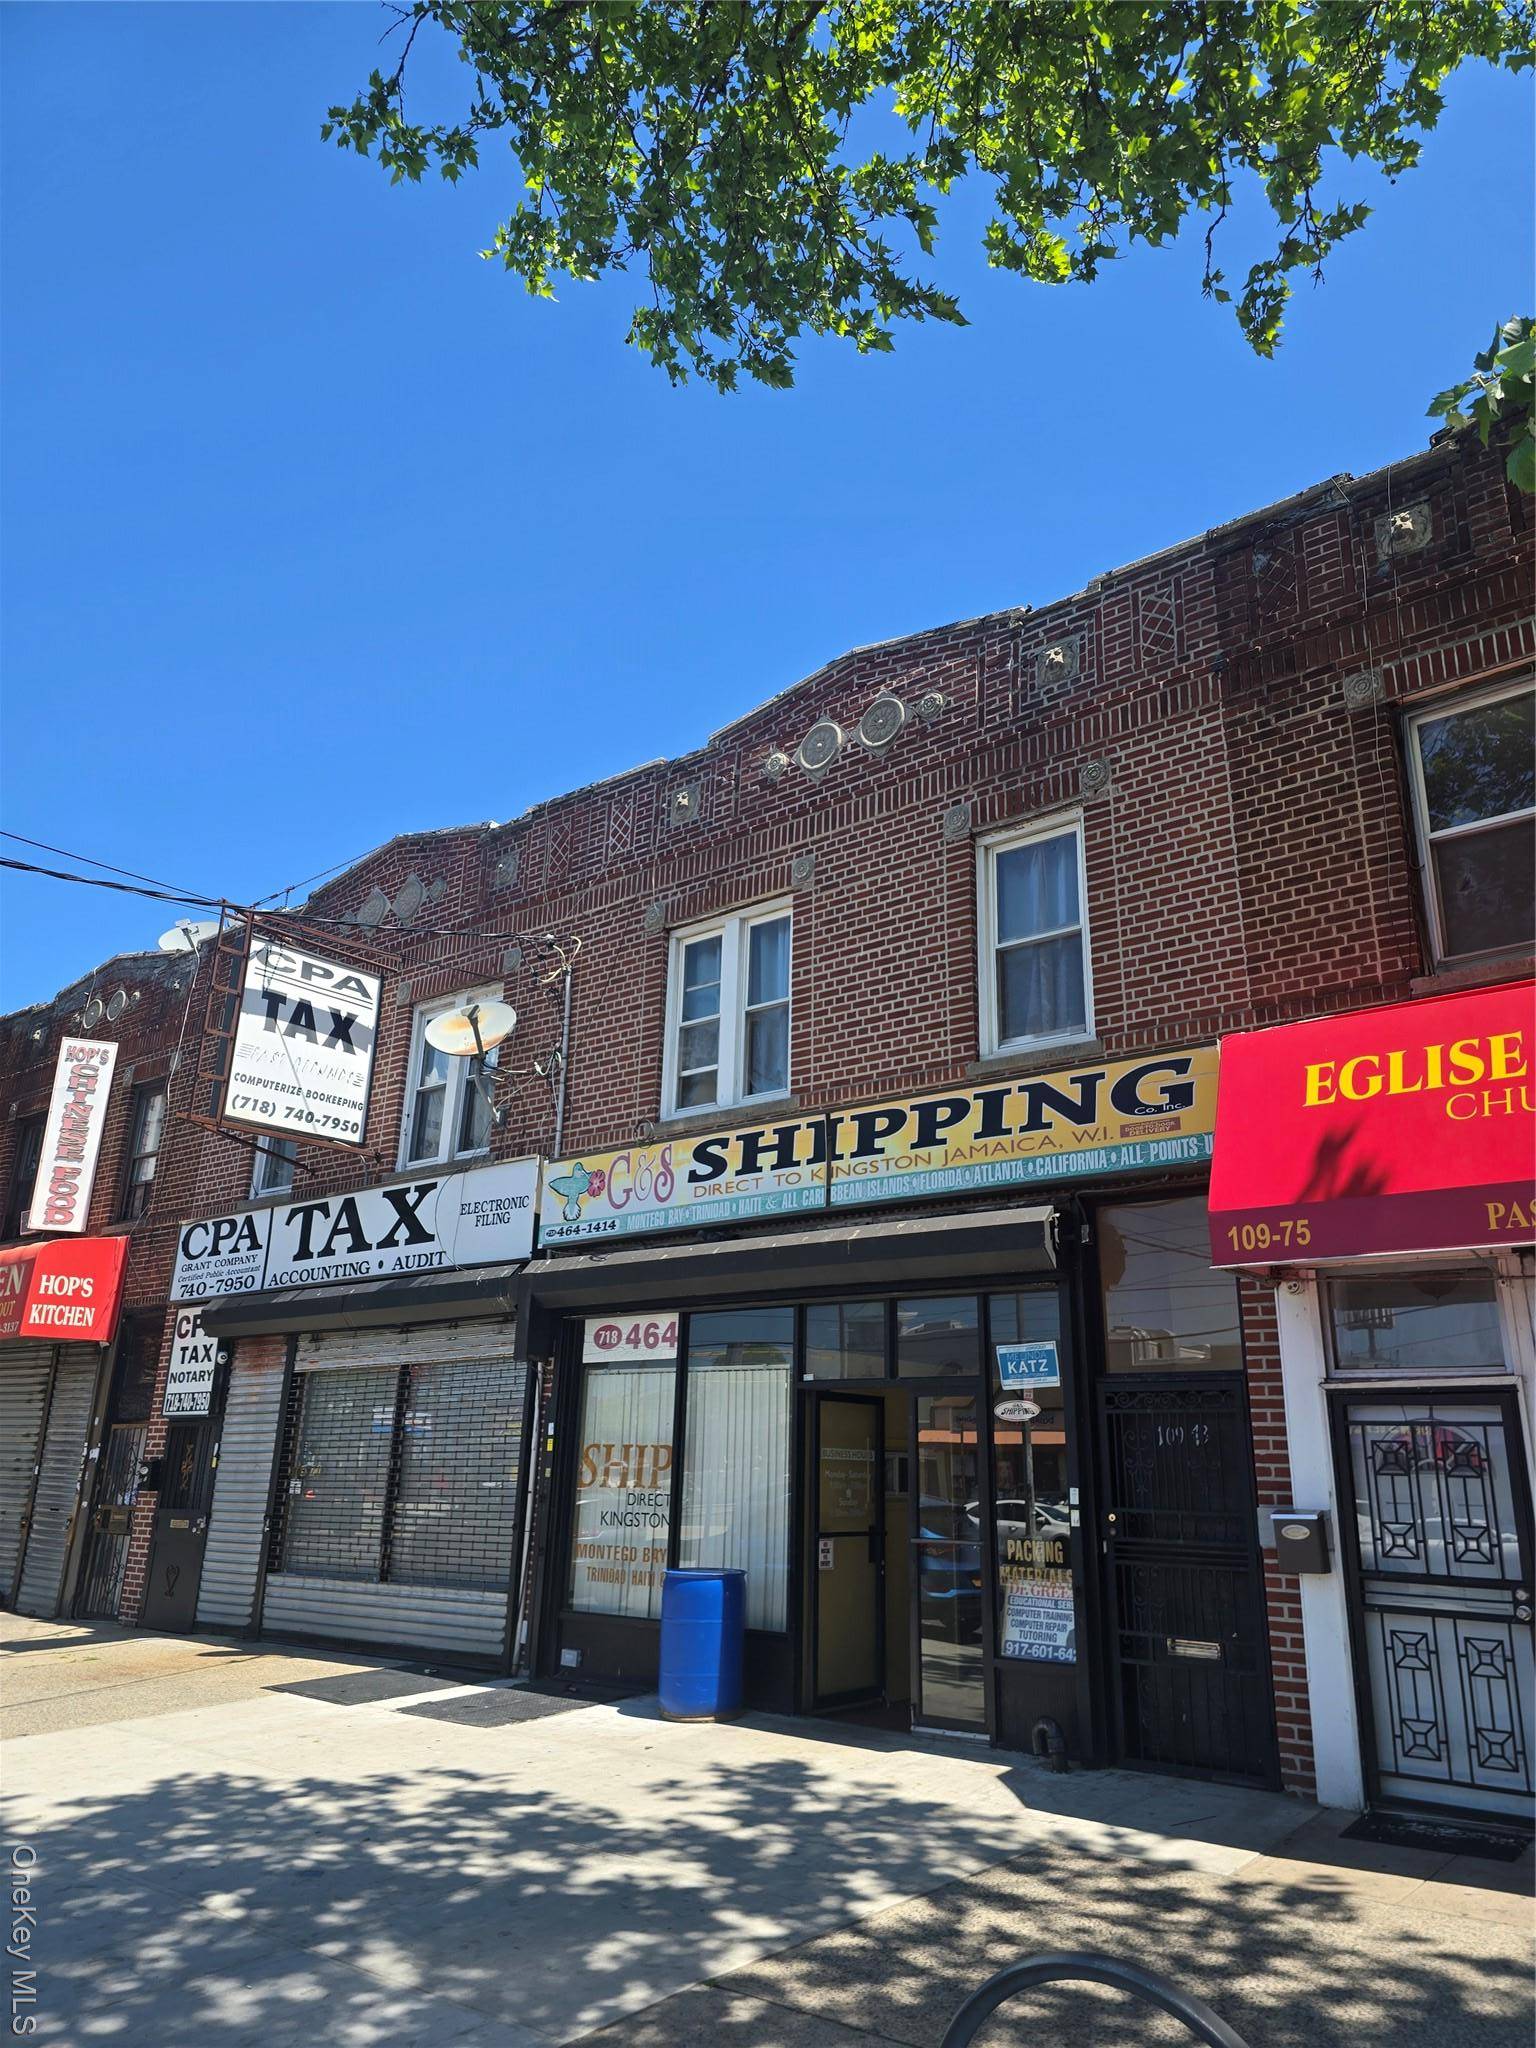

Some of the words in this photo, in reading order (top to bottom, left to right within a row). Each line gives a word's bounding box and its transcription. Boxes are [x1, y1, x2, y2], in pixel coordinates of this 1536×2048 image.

[256, 951, 372, 1000] CPA
[262, 990, 359, 1055] TAX
[65, 1045, 110, 1066] HOP'S
[1302, 1031, 1527, 1107] EGLISE
[234, 1072, 302, 1096] COMPUTERIZE
[305, 1089, 364, 1111] BOOKEEPING
[55, 1064, 100, 1164] CHINESE
[231, 1094, 277, 1117] (718)
[283, 1106, 360, 1134] 740-7950
[1135, 1107, 1158, 1115] Co.
[1162, 1102, 1185, 1111] Inc.
[687, 1057, 1196, 1184] SHIPPING
[1129, 1126, 1172, 1136] DELIVERY
[693, 1177, 764, 1199] DIRECT
[775, 1171, 802, 1186] TO
[810, 1154, 932, 1181] KINGSTON
[942, 1135, 1064, 1168] JAMAICA,
[1071, 1127, 1114, 1144] W.I.
[626, 1211, 665, 1230] MONTEGO
[692, 1202, 730, 1221] TRINIDAD
[738, 1197, 762, 1215] HAITI
[765, 1197, 780, 1210] &
[782, 1192, 797, 1208] ALL
[867, 1176, 910, 1197] ISLANDS
[920, 1168, 963, 1190] FLORIDA
[973, 1159, 1025, 1184] ATLANTA
[1035, 1149, 1107, 1175] CALIFORNIA
[1120, 1143, 1144, 1165] ALL
[1150, 1137, 1198, 1161] POINTS
[42, 1166, 82, 1226] FOOD
[460, 1195, 530, 1216] ELECTRONIC
[181, 1214, 263, 1260] CPA
[285, 1181, 438, 1262] TAX
[474, 1211, 511, 1228] FILING
[557, 1219, 617, 1237] 464-1414
[1227, 1219, 1311, 1252] 109-75
[178, 1272, 205, 1283] Certified
[205, 1270, 224, 1279] Public
[225, 1265, 261, 1276] Accountant
[181, 1261, 212, 1273] GRANT
[214, 1254, 259, 1268] COMPANY
[268, 1260, 371, 1287] ACCOUNTING
[392, 1250, 447, 1271] AUDIT
[39, 1274, 94, 1298] HOP'S
[180, 1275, 255, 1298] 740-7950
[28, 1303, 96, 1327] KITCHEN
[177, 1313, 206, 1339] CP
[599, 1329, 618, 1345] 718
[625, 1321, 677, 1349] 464
[180, 1343, 214, 1364] TAX
[169, 1369, 214, 1384] NOTARY
[1008, 1359, 1049, 1374] KATZ
[166, 1392, 210, 1412] 718-740-7950
[577, 1443, 672, 1488] SHIP
[628, 1493, 671, 1507] DIRECT
[600, 1511, 671, 1528] KINGSTON
[576, 1543, 637, 1562] MONTEGO
[643, 1547, 667, 1563] BAY
[1007, 1539, 1064, 1564] PACKING
[587, 1566, 626, 1584] TRINIDAD
[632, 1570, 655, 1587] HAITI
[1007, 1608, 1042, 1619] COMPUTER
[1010, 1597, 1056, 1608] EDUCATIONAL
[1010, 1619, 1044, 1630] COMPUTER
[1045, 1622, 1068, 1632] REPAIR
[1019, 1631, 1058, 1642] TUTORING
